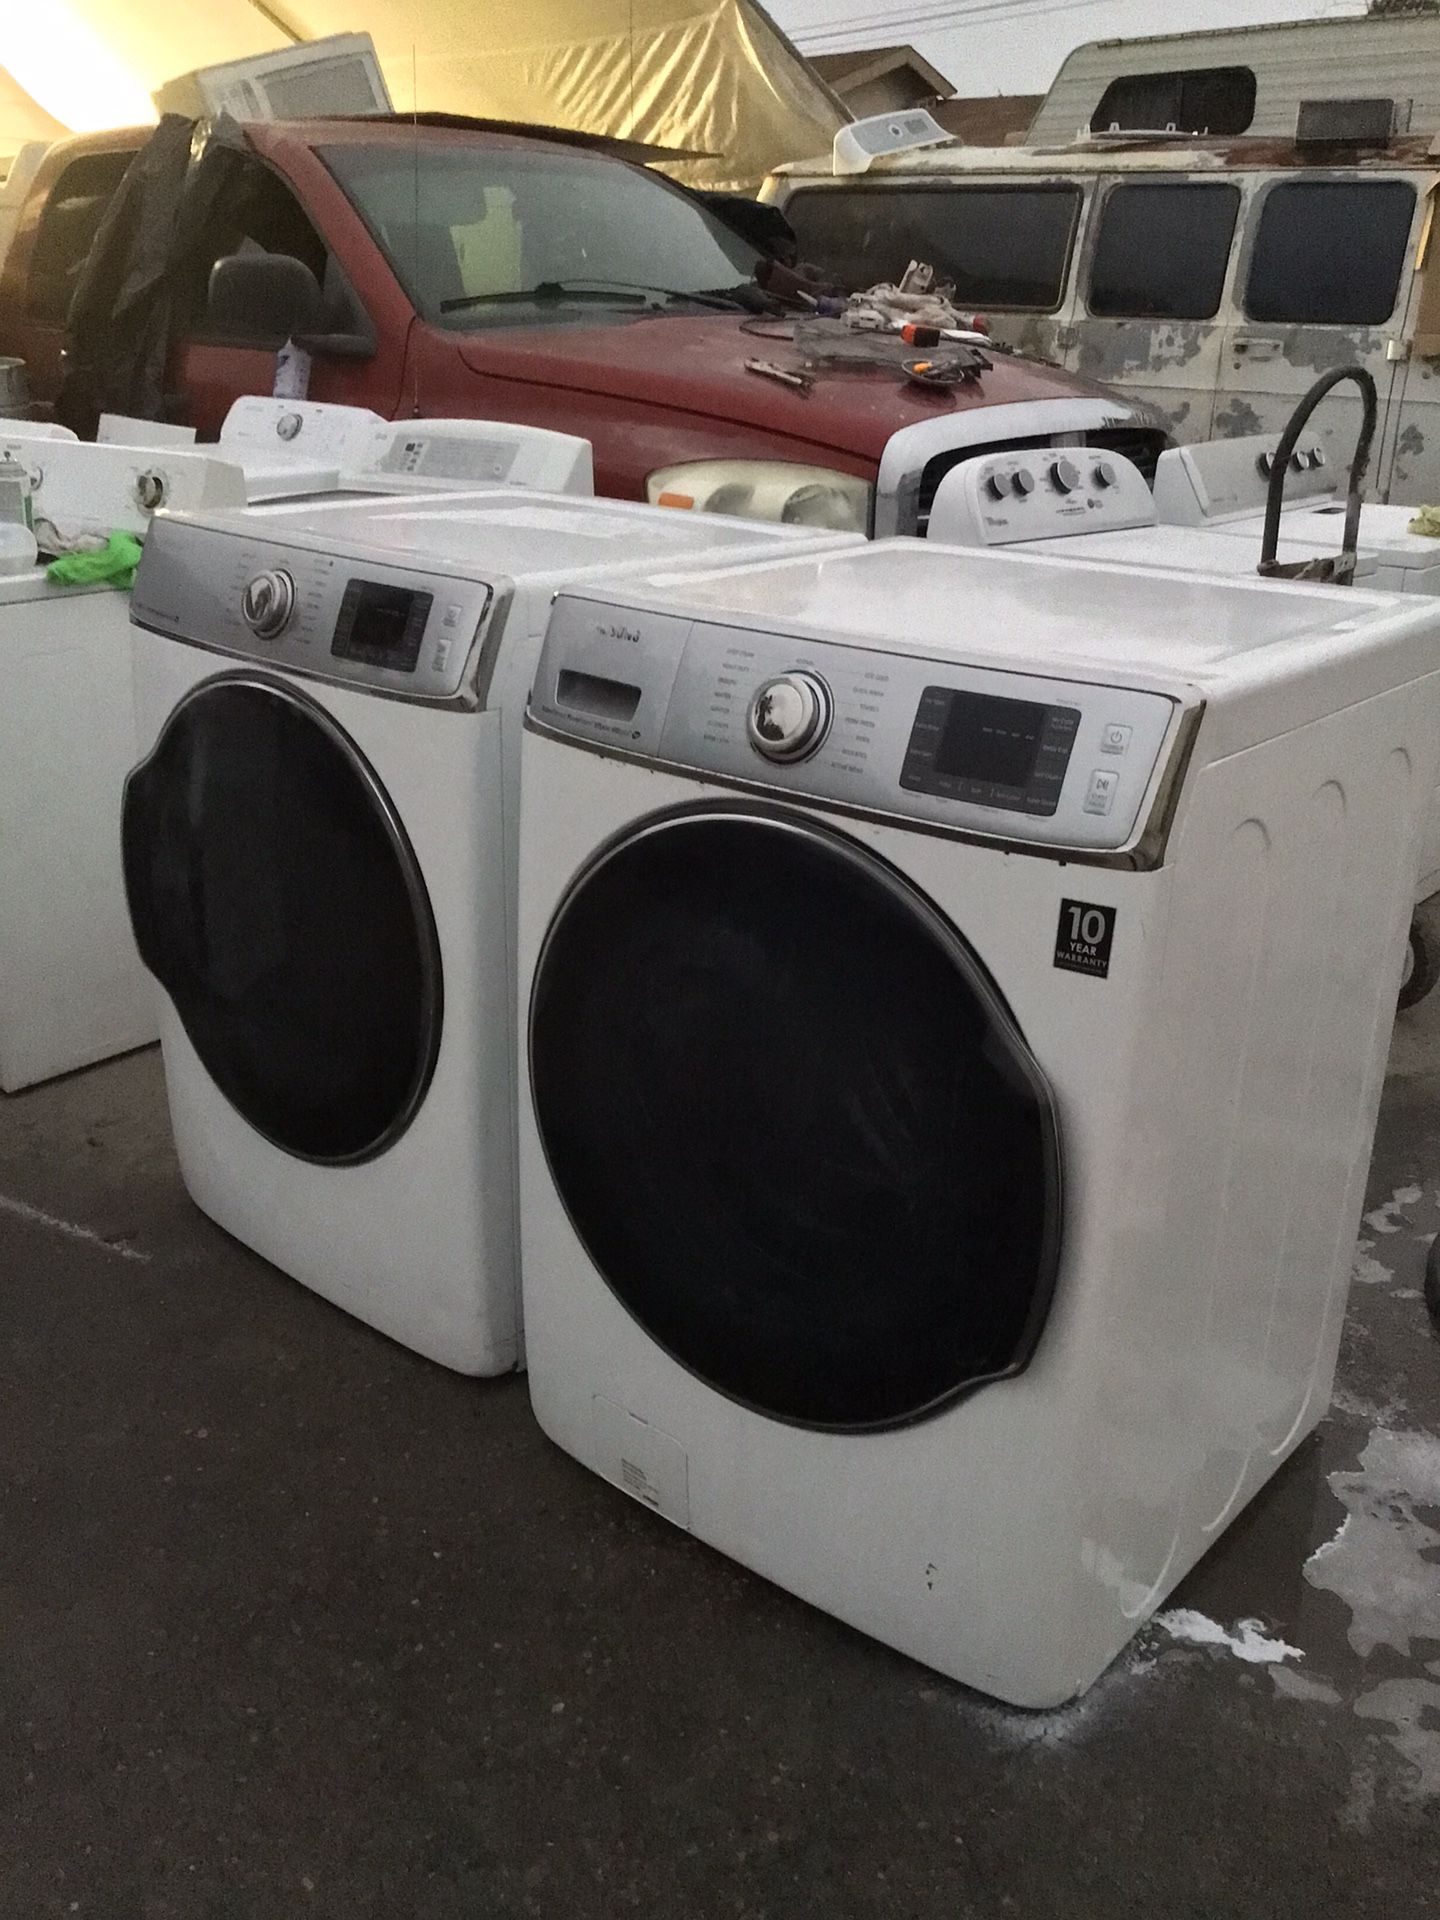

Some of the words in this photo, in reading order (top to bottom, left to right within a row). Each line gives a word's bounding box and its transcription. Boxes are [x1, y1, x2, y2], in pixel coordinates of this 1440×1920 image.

[1068, 906, 1106, 944] 10
[1070, 942, 1097, 956] YEAR
[1057, 950, 1107, 967] WARRANTY
